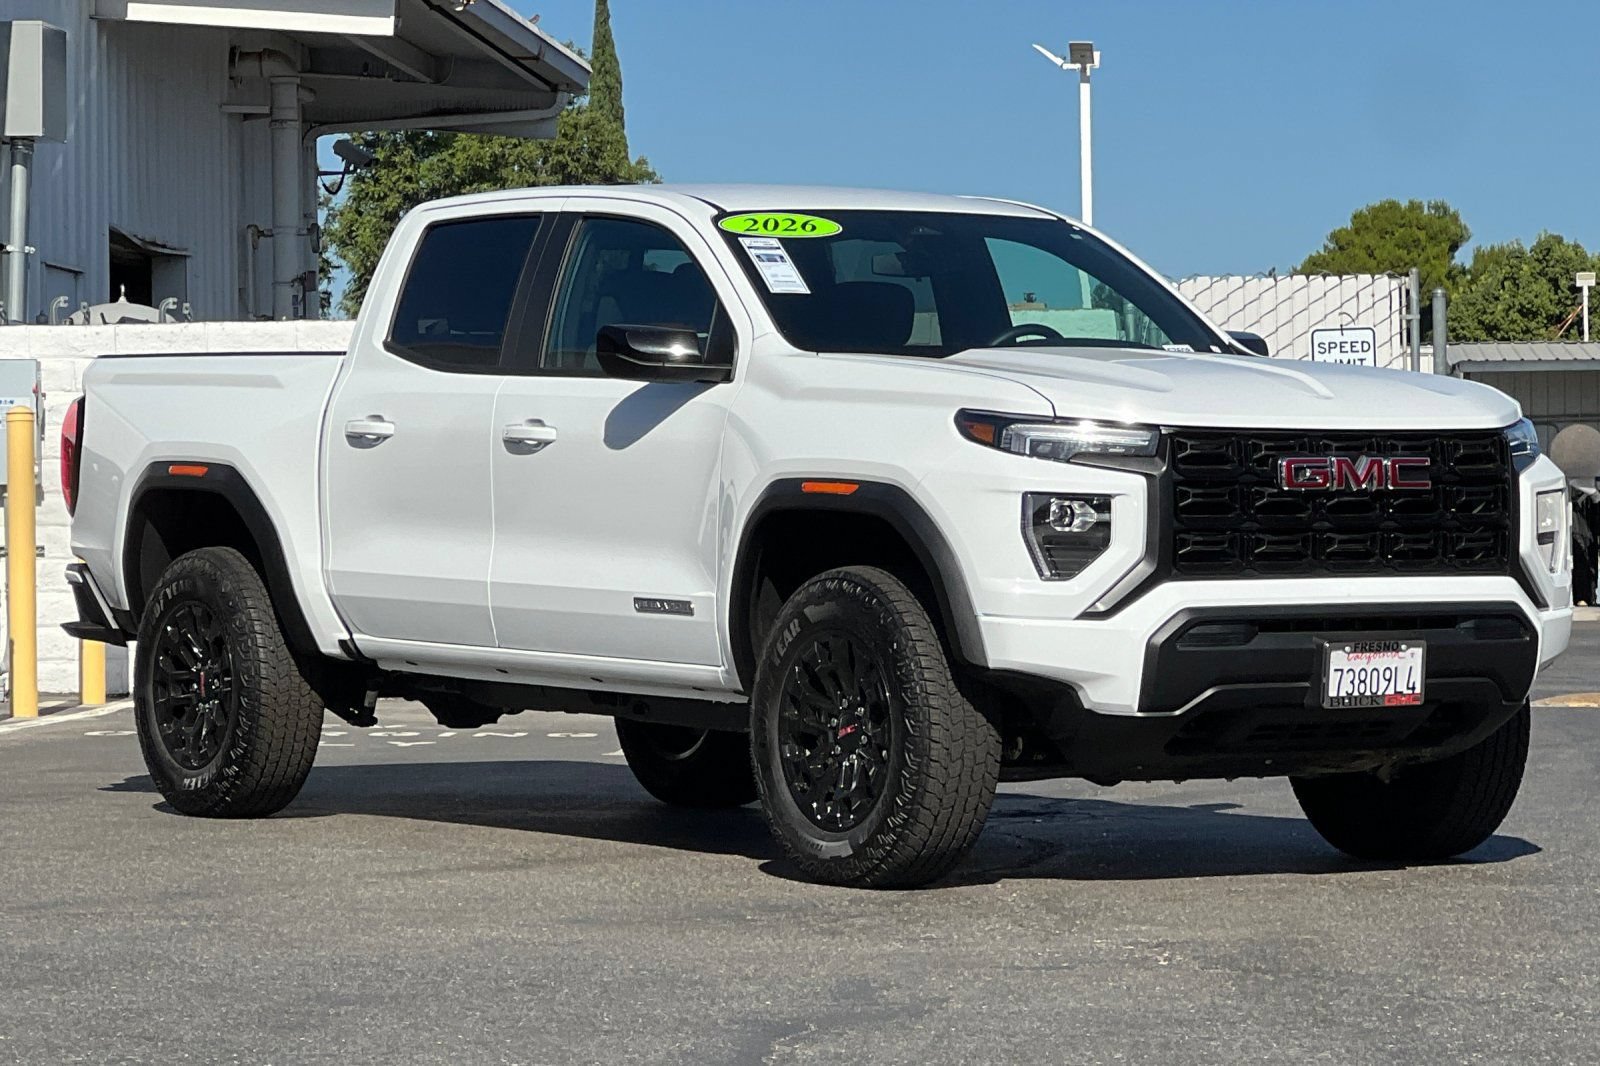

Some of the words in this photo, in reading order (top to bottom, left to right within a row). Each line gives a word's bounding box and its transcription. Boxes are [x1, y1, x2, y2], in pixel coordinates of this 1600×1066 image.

[743, 217, 817, 233] 2026
[1317, 340, 1371, 354] SPEED
[1279, 456, 1431, 491] GMC
[1354, 641, 1399, 652] FRESNO
[1334, 666, 1416, 696] 73809L4
